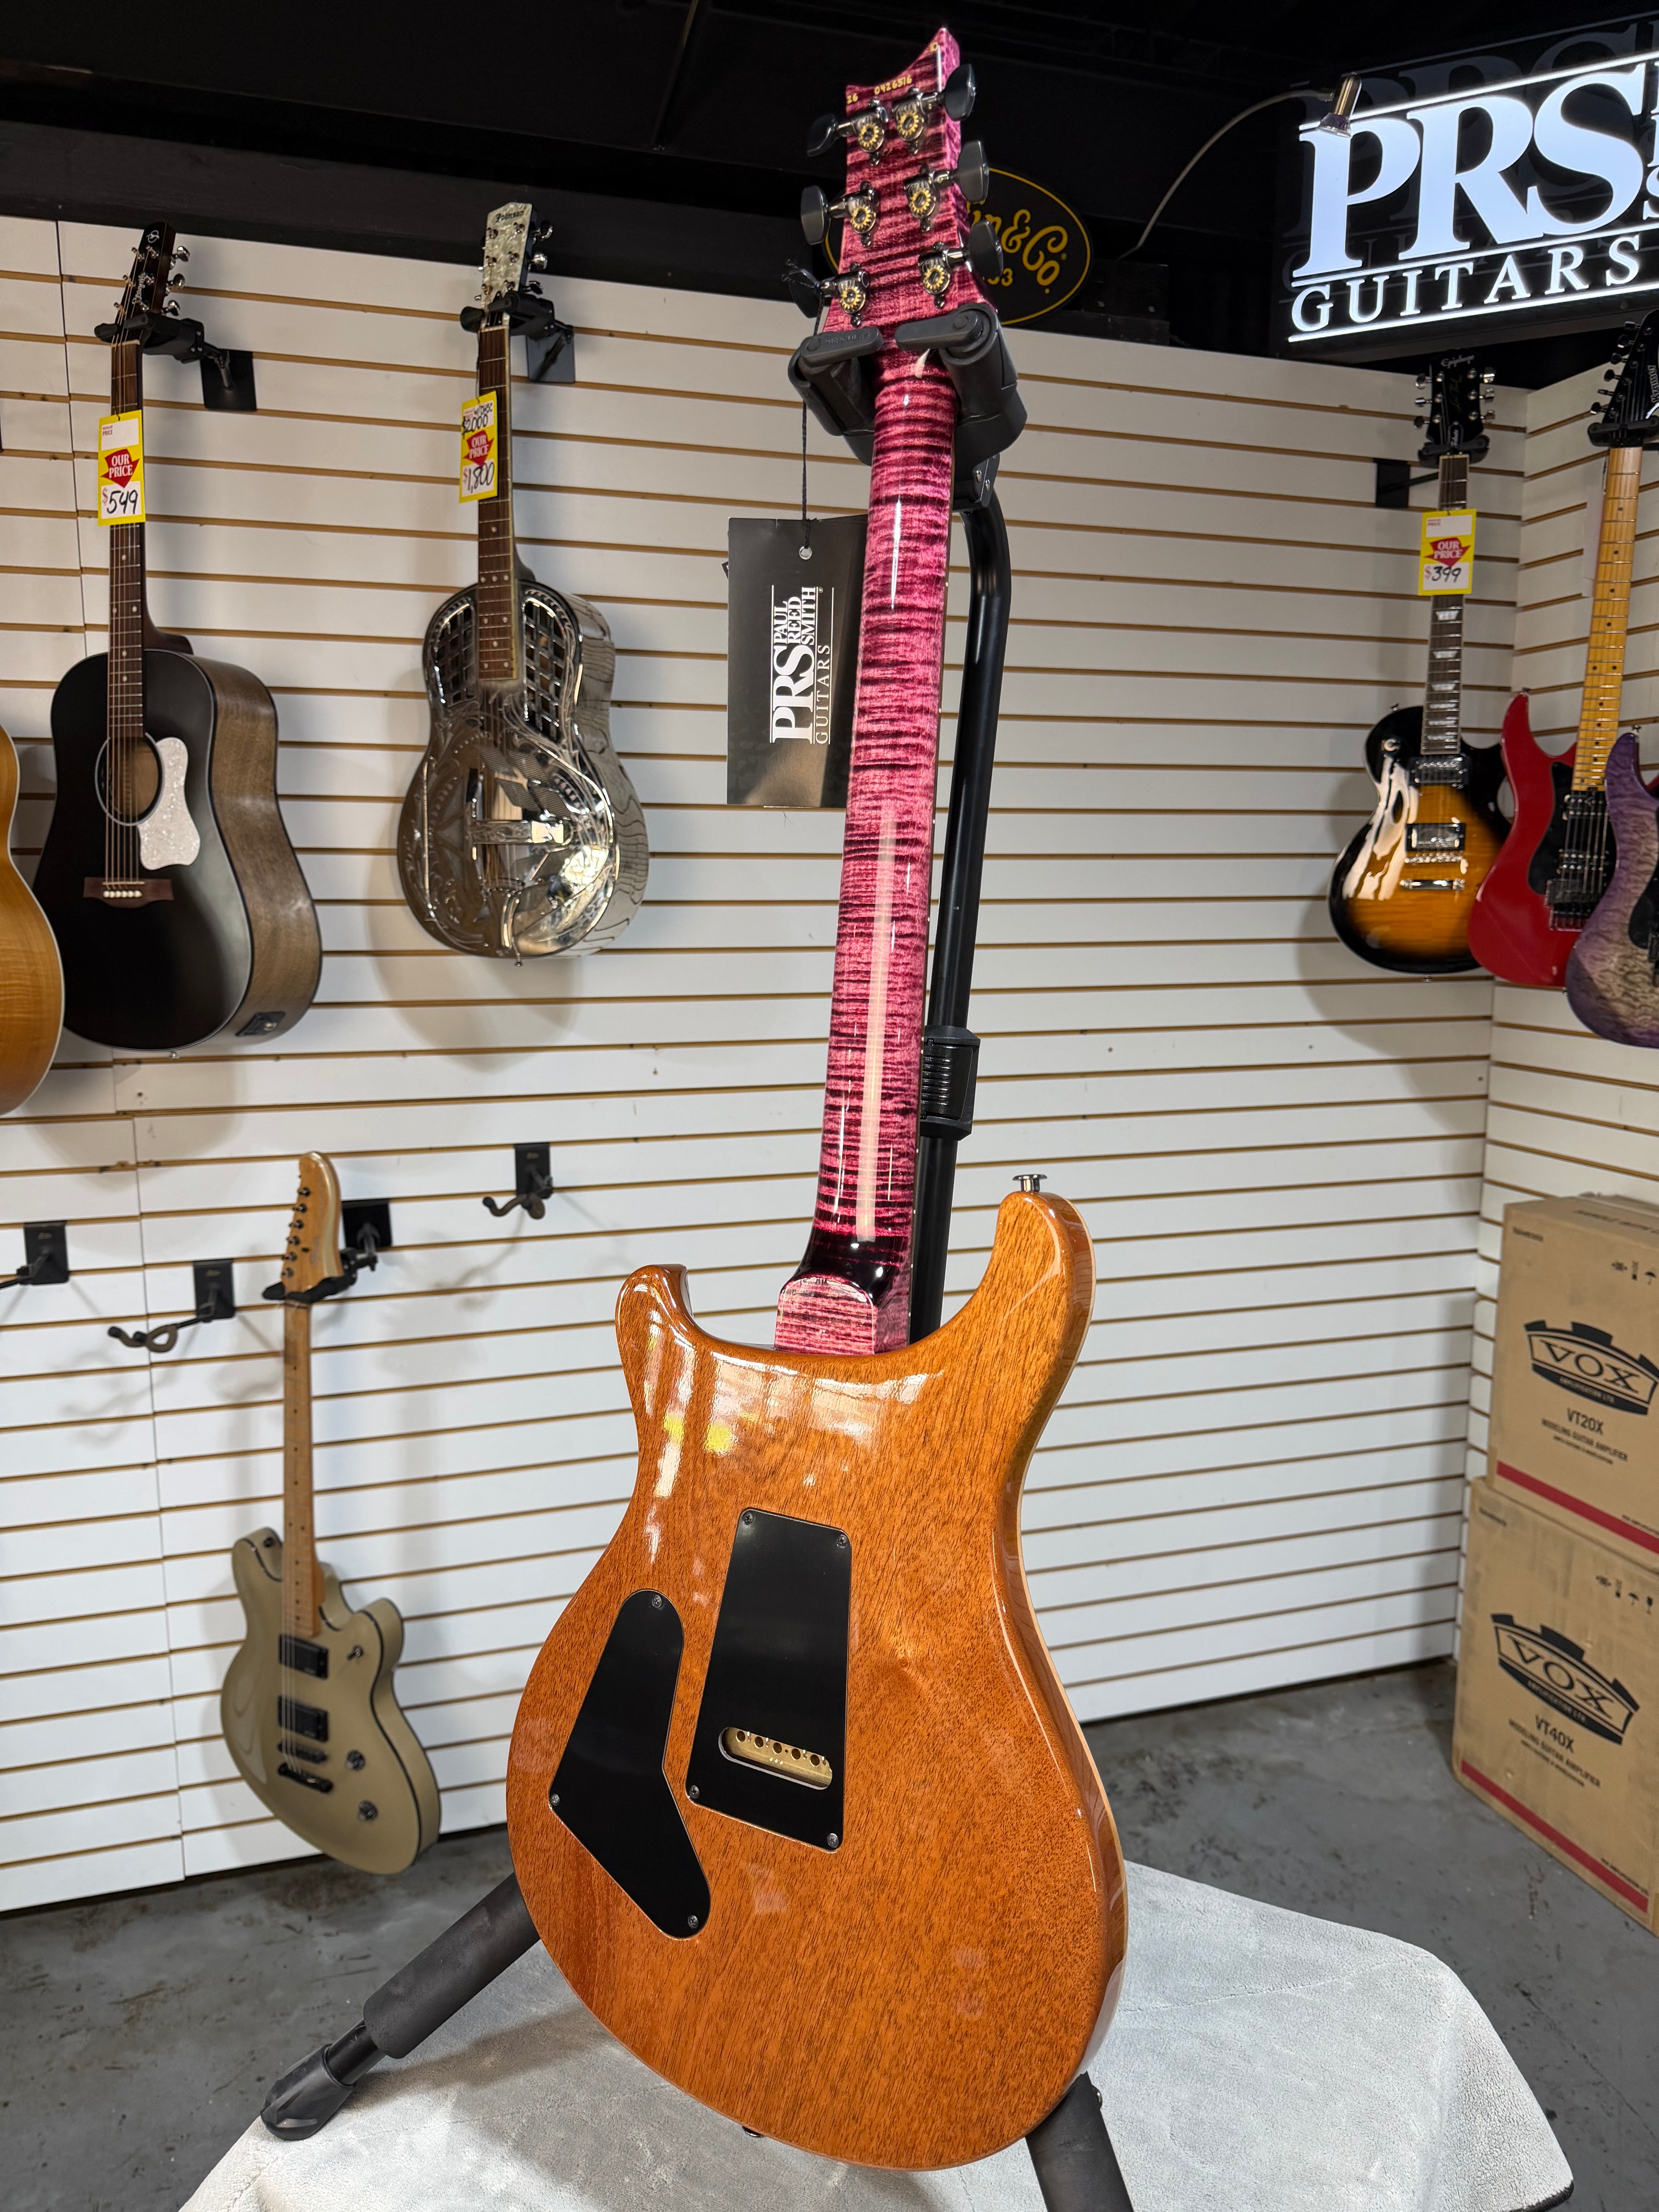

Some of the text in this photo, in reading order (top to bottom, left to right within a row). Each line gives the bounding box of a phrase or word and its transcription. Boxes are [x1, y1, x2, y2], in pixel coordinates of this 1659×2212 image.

[847, 93, 858, 105] 26
[1293, 62, 1645, 278] PRS
[1291, 235, 1640, 332] GUITARS
[111, 453, 130, 466] OUR
[469, 444, 489, 459] PRICE
[471, 435, 487, 448] OUR
[109, 465, 133, 478] PRICE
[1434, 550, 1463, 560] PRICE
[1437, 541, 1460, 550] OUR
[774, 601, 788, 644] PAUL
[788, 597, 801, 644] REED
[801, 586, 816, 646] SMITH
[772, 645, 815, 744] PRS
[816, 645, 830, 744] GUITARS
[1539, 1339, 1641, 1394] VOX
[1567, 1407, 1604, 1436] VT20X
[1507, 1634, 1614, 1719] VOX
[1535, 1714, 1575, 1753] VT40X
